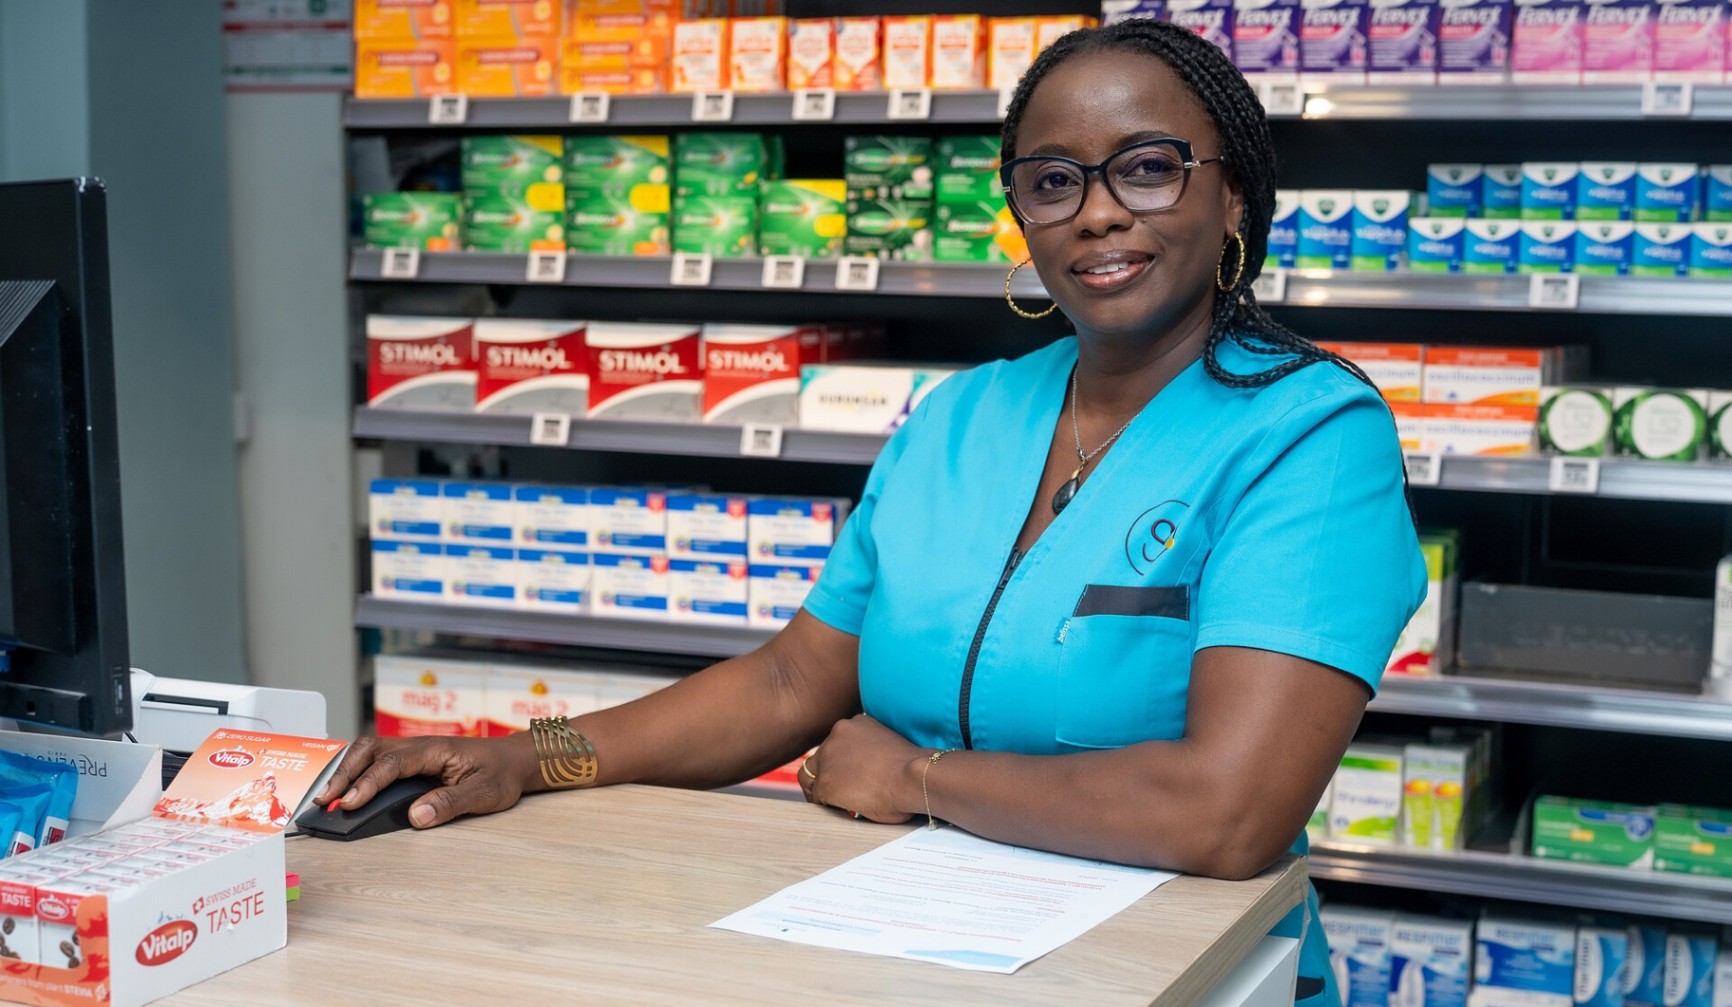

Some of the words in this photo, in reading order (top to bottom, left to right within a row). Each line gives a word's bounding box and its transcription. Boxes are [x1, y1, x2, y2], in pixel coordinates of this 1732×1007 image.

[215, 752, 250, 766] Vitalp
[260, 756, 308, 771] TASTE
[0, 892, 31, 908] TASTE
[206, 888, 232, 906] SWISS
[232, 878, 257, 896] MADE
[206, 891, 264, 934] TASTE
[141, 928, 194, 961] Vitalp
